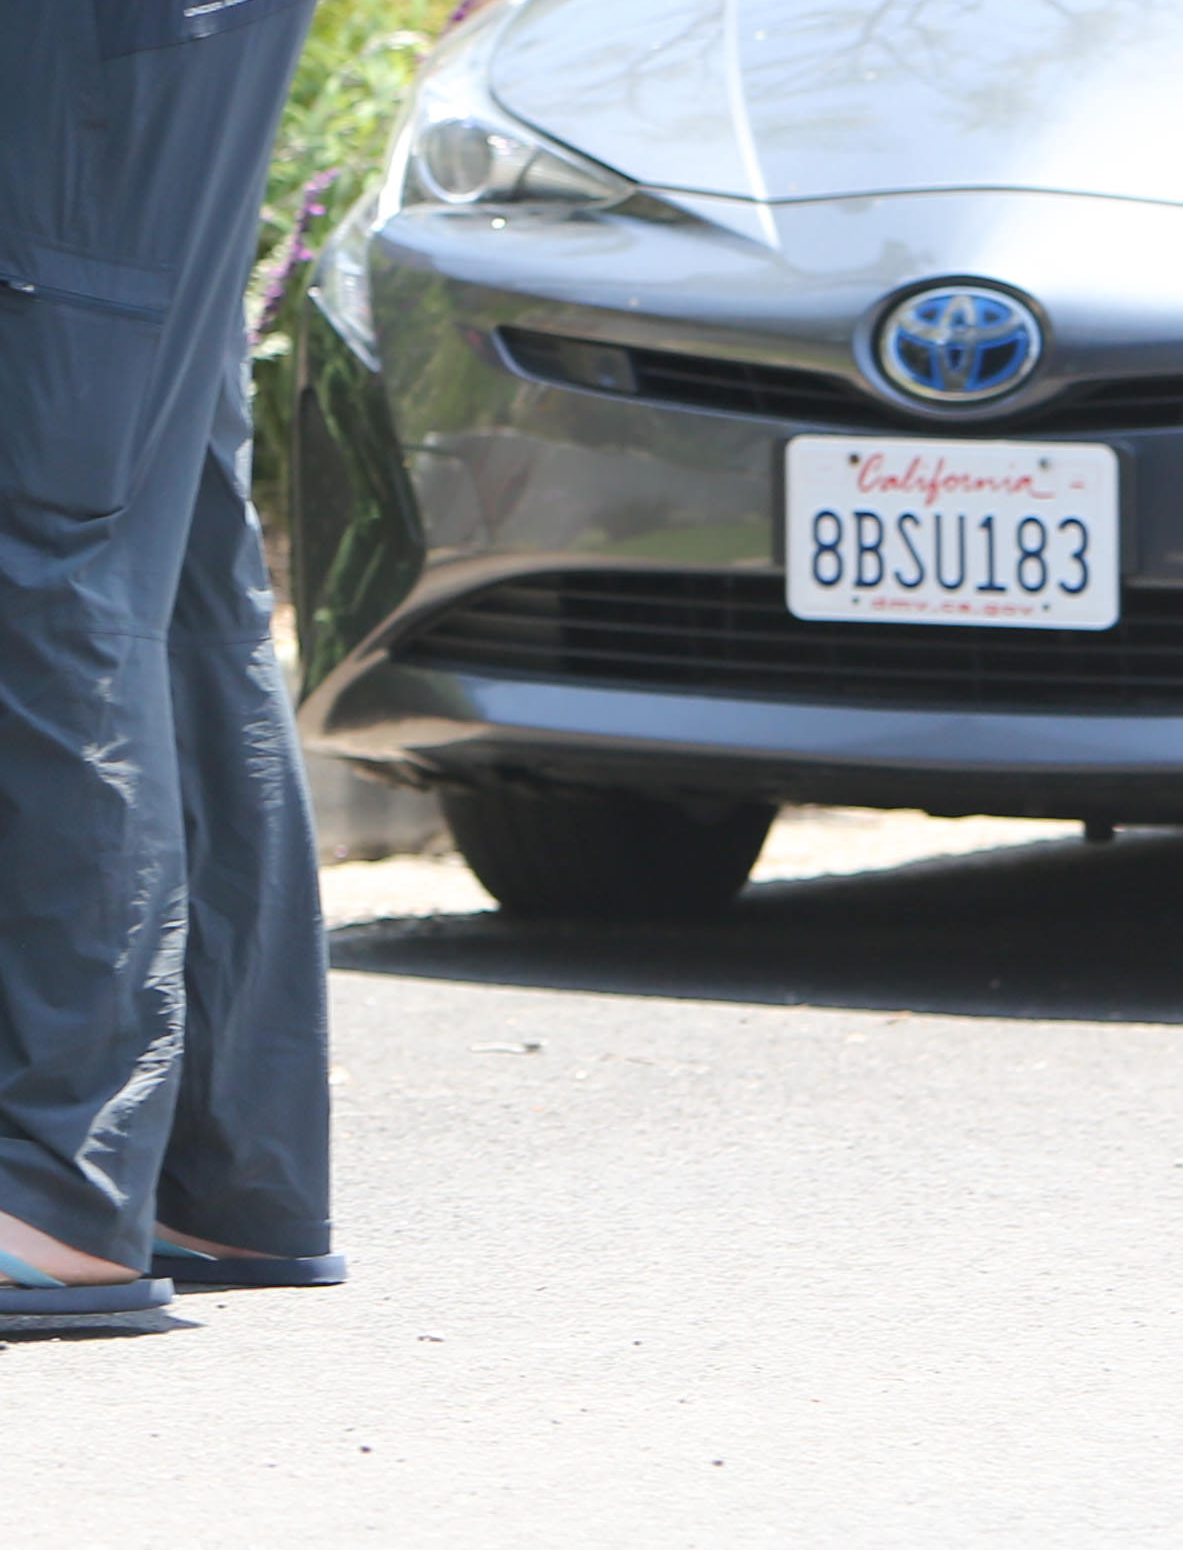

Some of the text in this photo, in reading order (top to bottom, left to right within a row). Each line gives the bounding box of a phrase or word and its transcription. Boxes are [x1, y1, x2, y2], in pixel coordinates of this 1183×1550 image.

[857, 453, 1056, 506] California
[811, 510, 1090, 595] 8BSU183
[871, 596, 1034, 616] dmv.ca.gov
